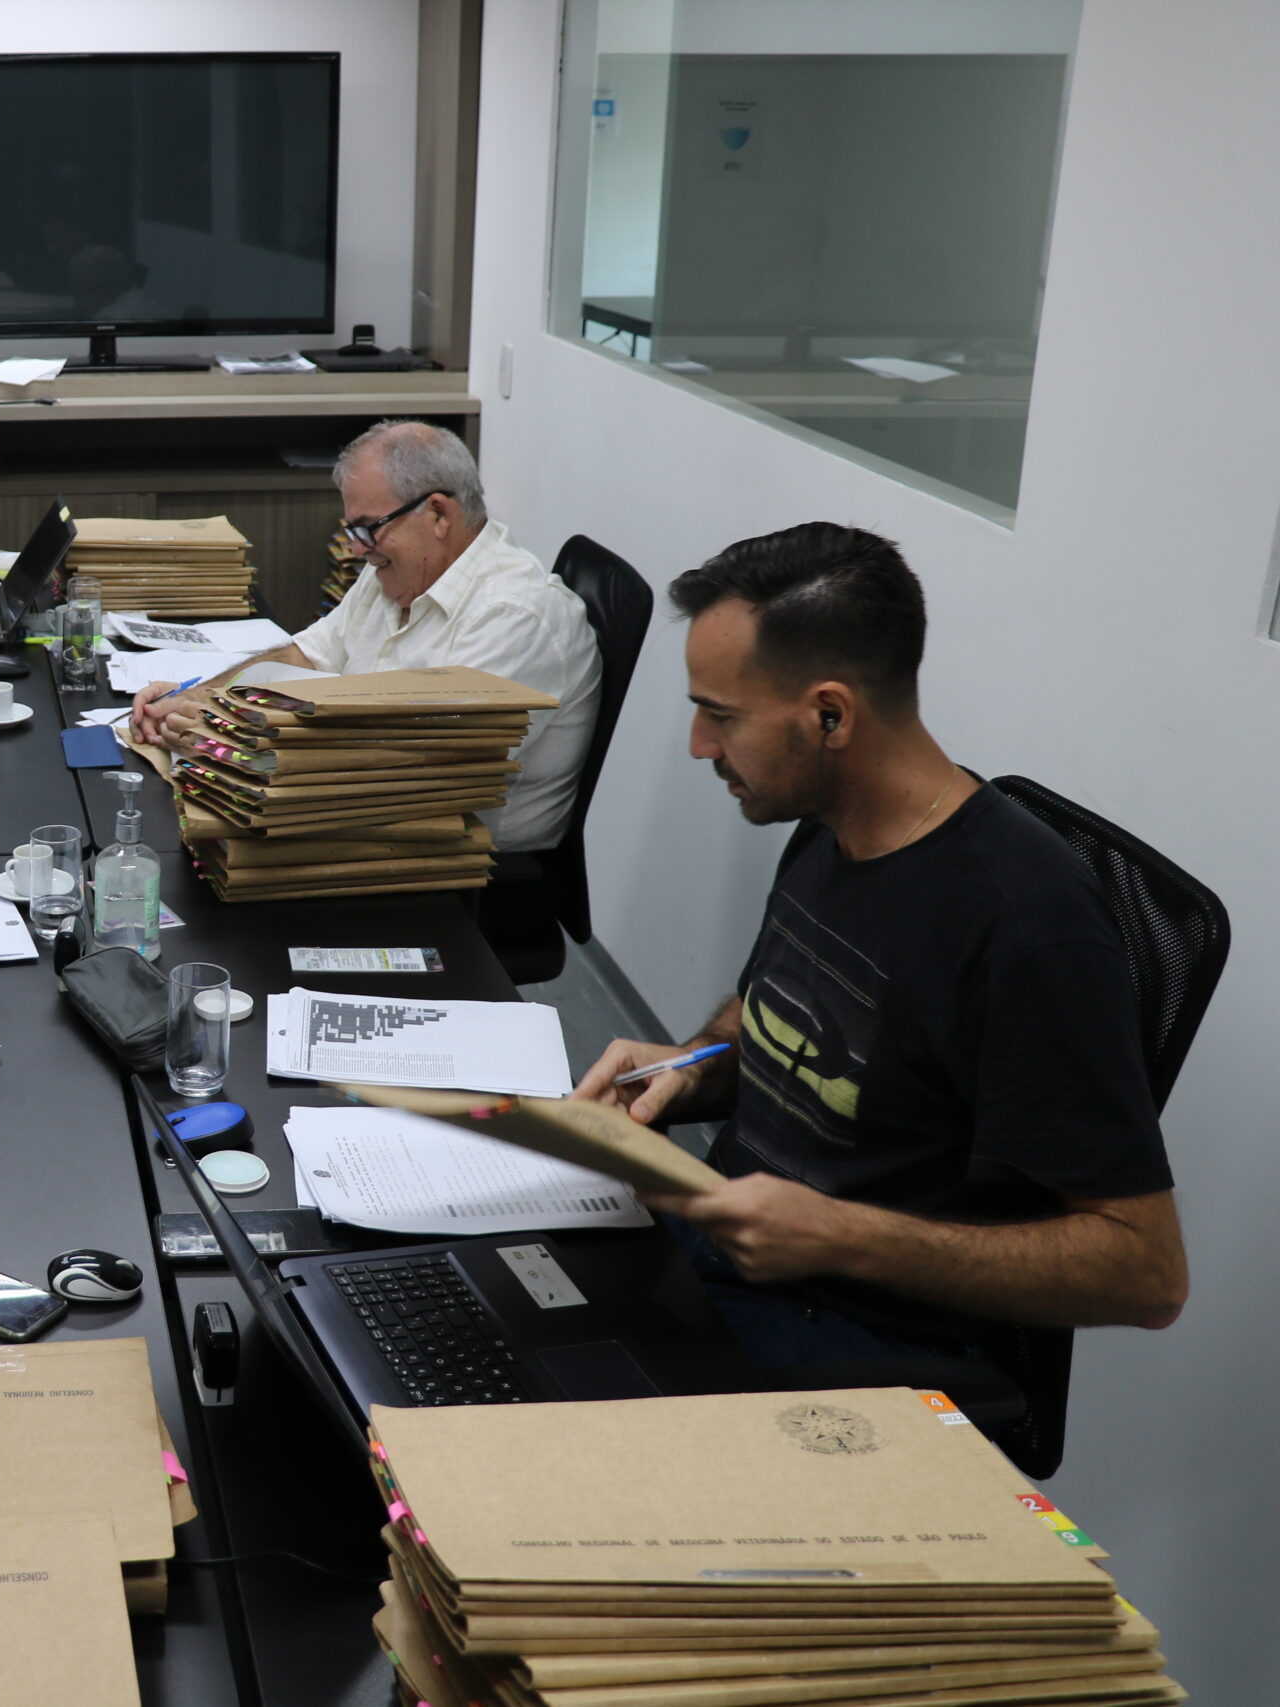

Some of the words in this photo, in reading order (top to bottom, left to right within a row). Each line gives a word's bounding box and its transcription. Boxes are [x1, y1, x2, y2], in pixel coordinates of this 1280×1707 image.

[2, 1390, 44, 1398] REGIONAL
[49, 1389, 94, 1397] CONSELHO
[930, 1397, 943, 1407] 4
[1022, 1497, 1042, 1512] 2
[1061, 1531, 1079, 1543] 9
